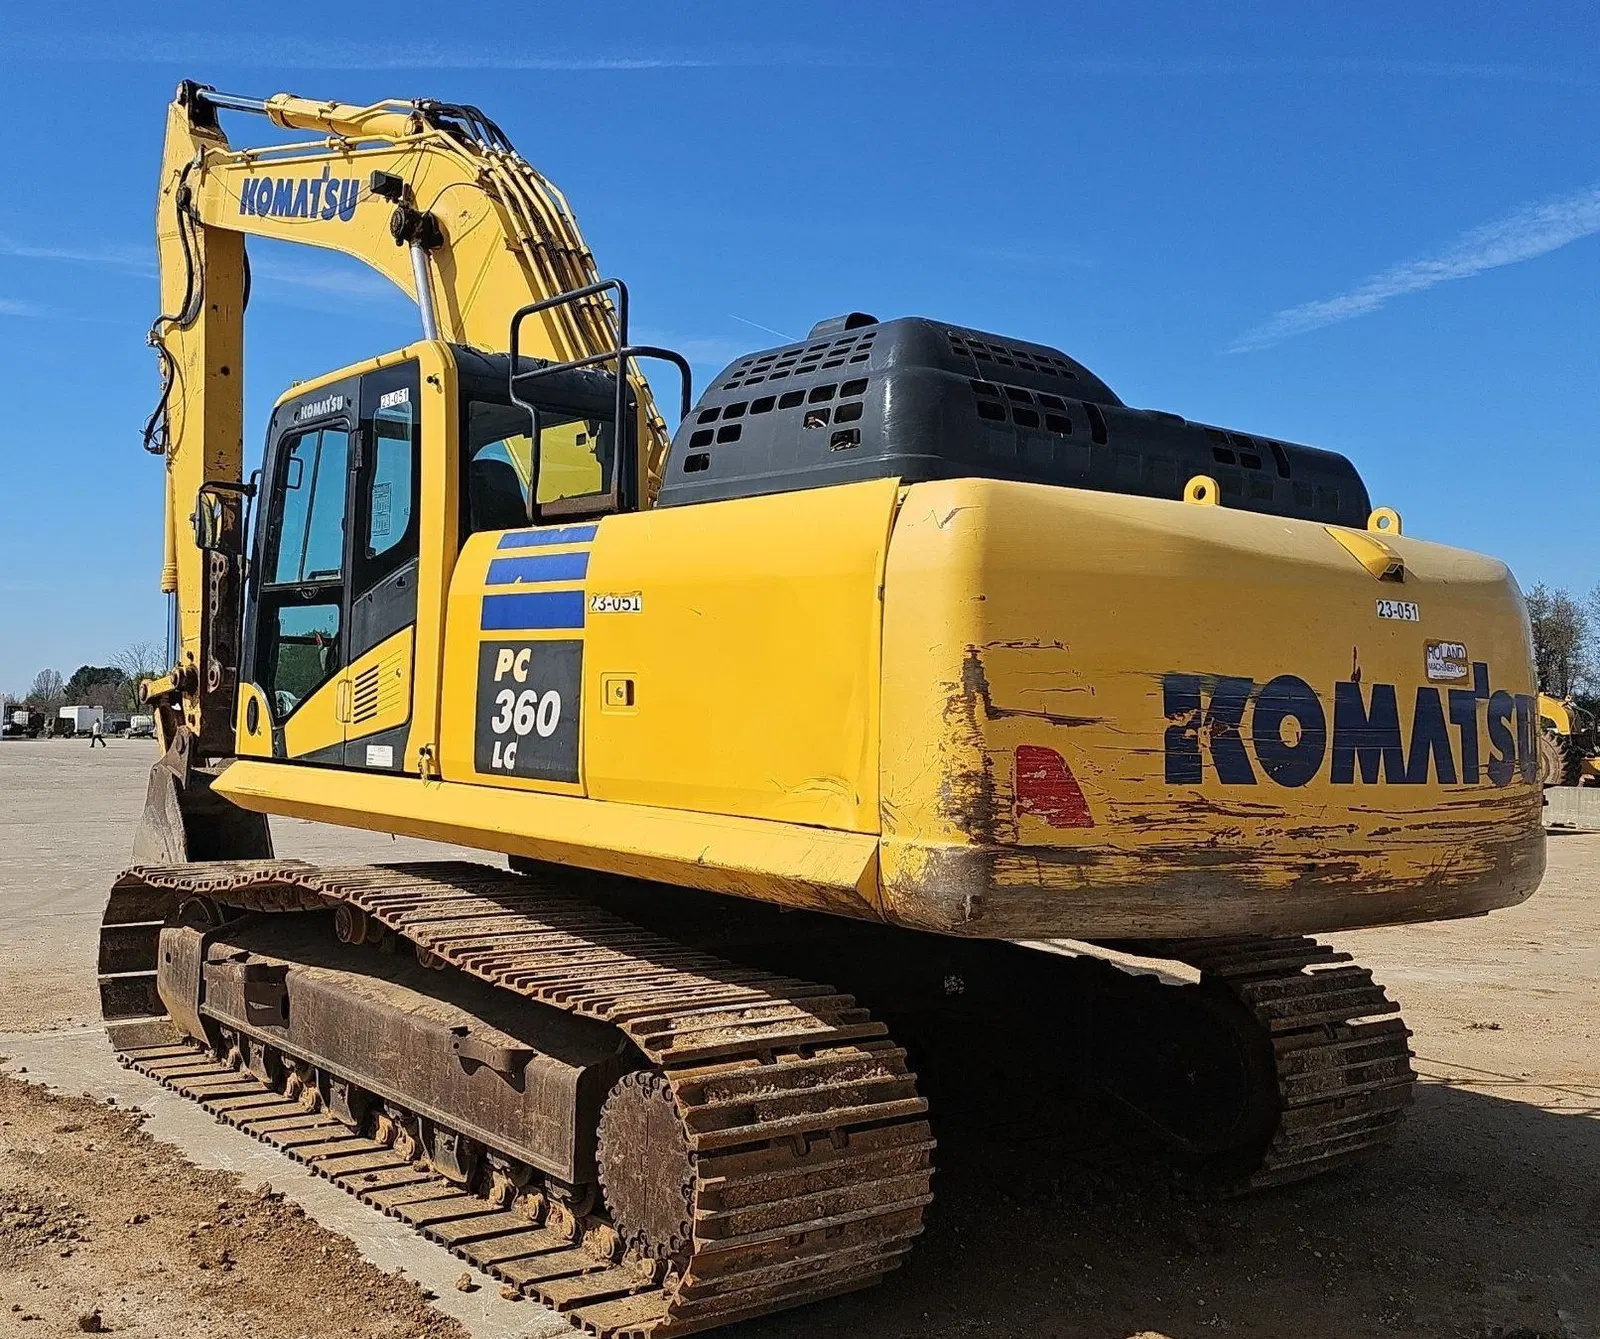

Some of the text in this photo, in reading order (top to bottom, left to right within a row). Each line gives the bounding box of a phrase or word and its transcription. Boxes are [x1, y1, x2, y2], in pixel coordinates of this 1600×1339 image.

[239, 166, 360, 222] KOMATSU
[301, 395, 344, 419] KOMATSU
[381, 390, 408, 408] 23-051
[1377, 600, 1418, 620] 23-051
[494, 648, 532, 683] PC
[491, 689, 562, 738] 360
[1164, 662, 1538, 788] KOMATSU
[491, 741, 518, 770] LC
